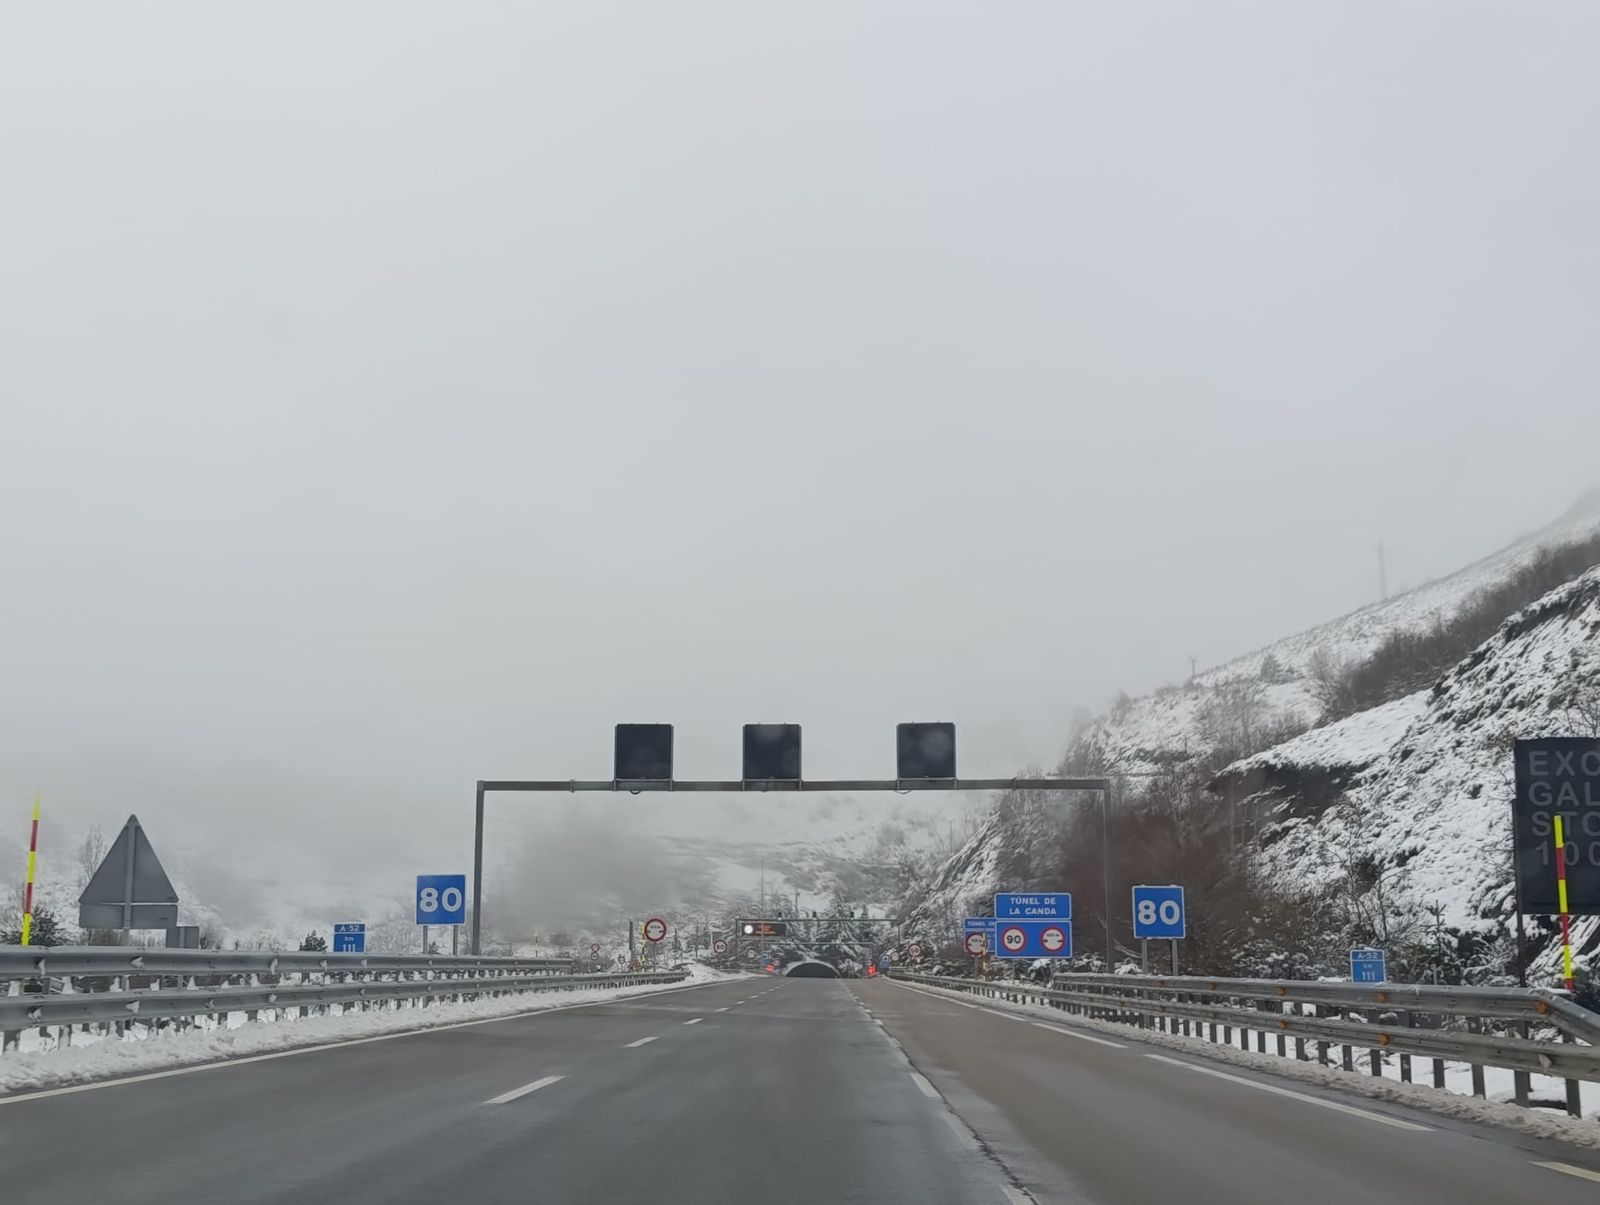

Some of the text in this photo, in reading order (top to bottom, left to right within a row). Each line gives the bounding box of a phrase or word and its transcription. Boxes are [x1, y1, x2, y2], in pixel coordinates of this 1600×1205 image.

[1528, 781, 1600, 806] GAL
[420, 887, 462, 912] 80
[1009, 896, 1056, 905] TÚNEL DE
[1138, 900, 1180, 925] 80
[1006, 935, 1021, 944] 90
[1362, 971, 1376, 981] 111
